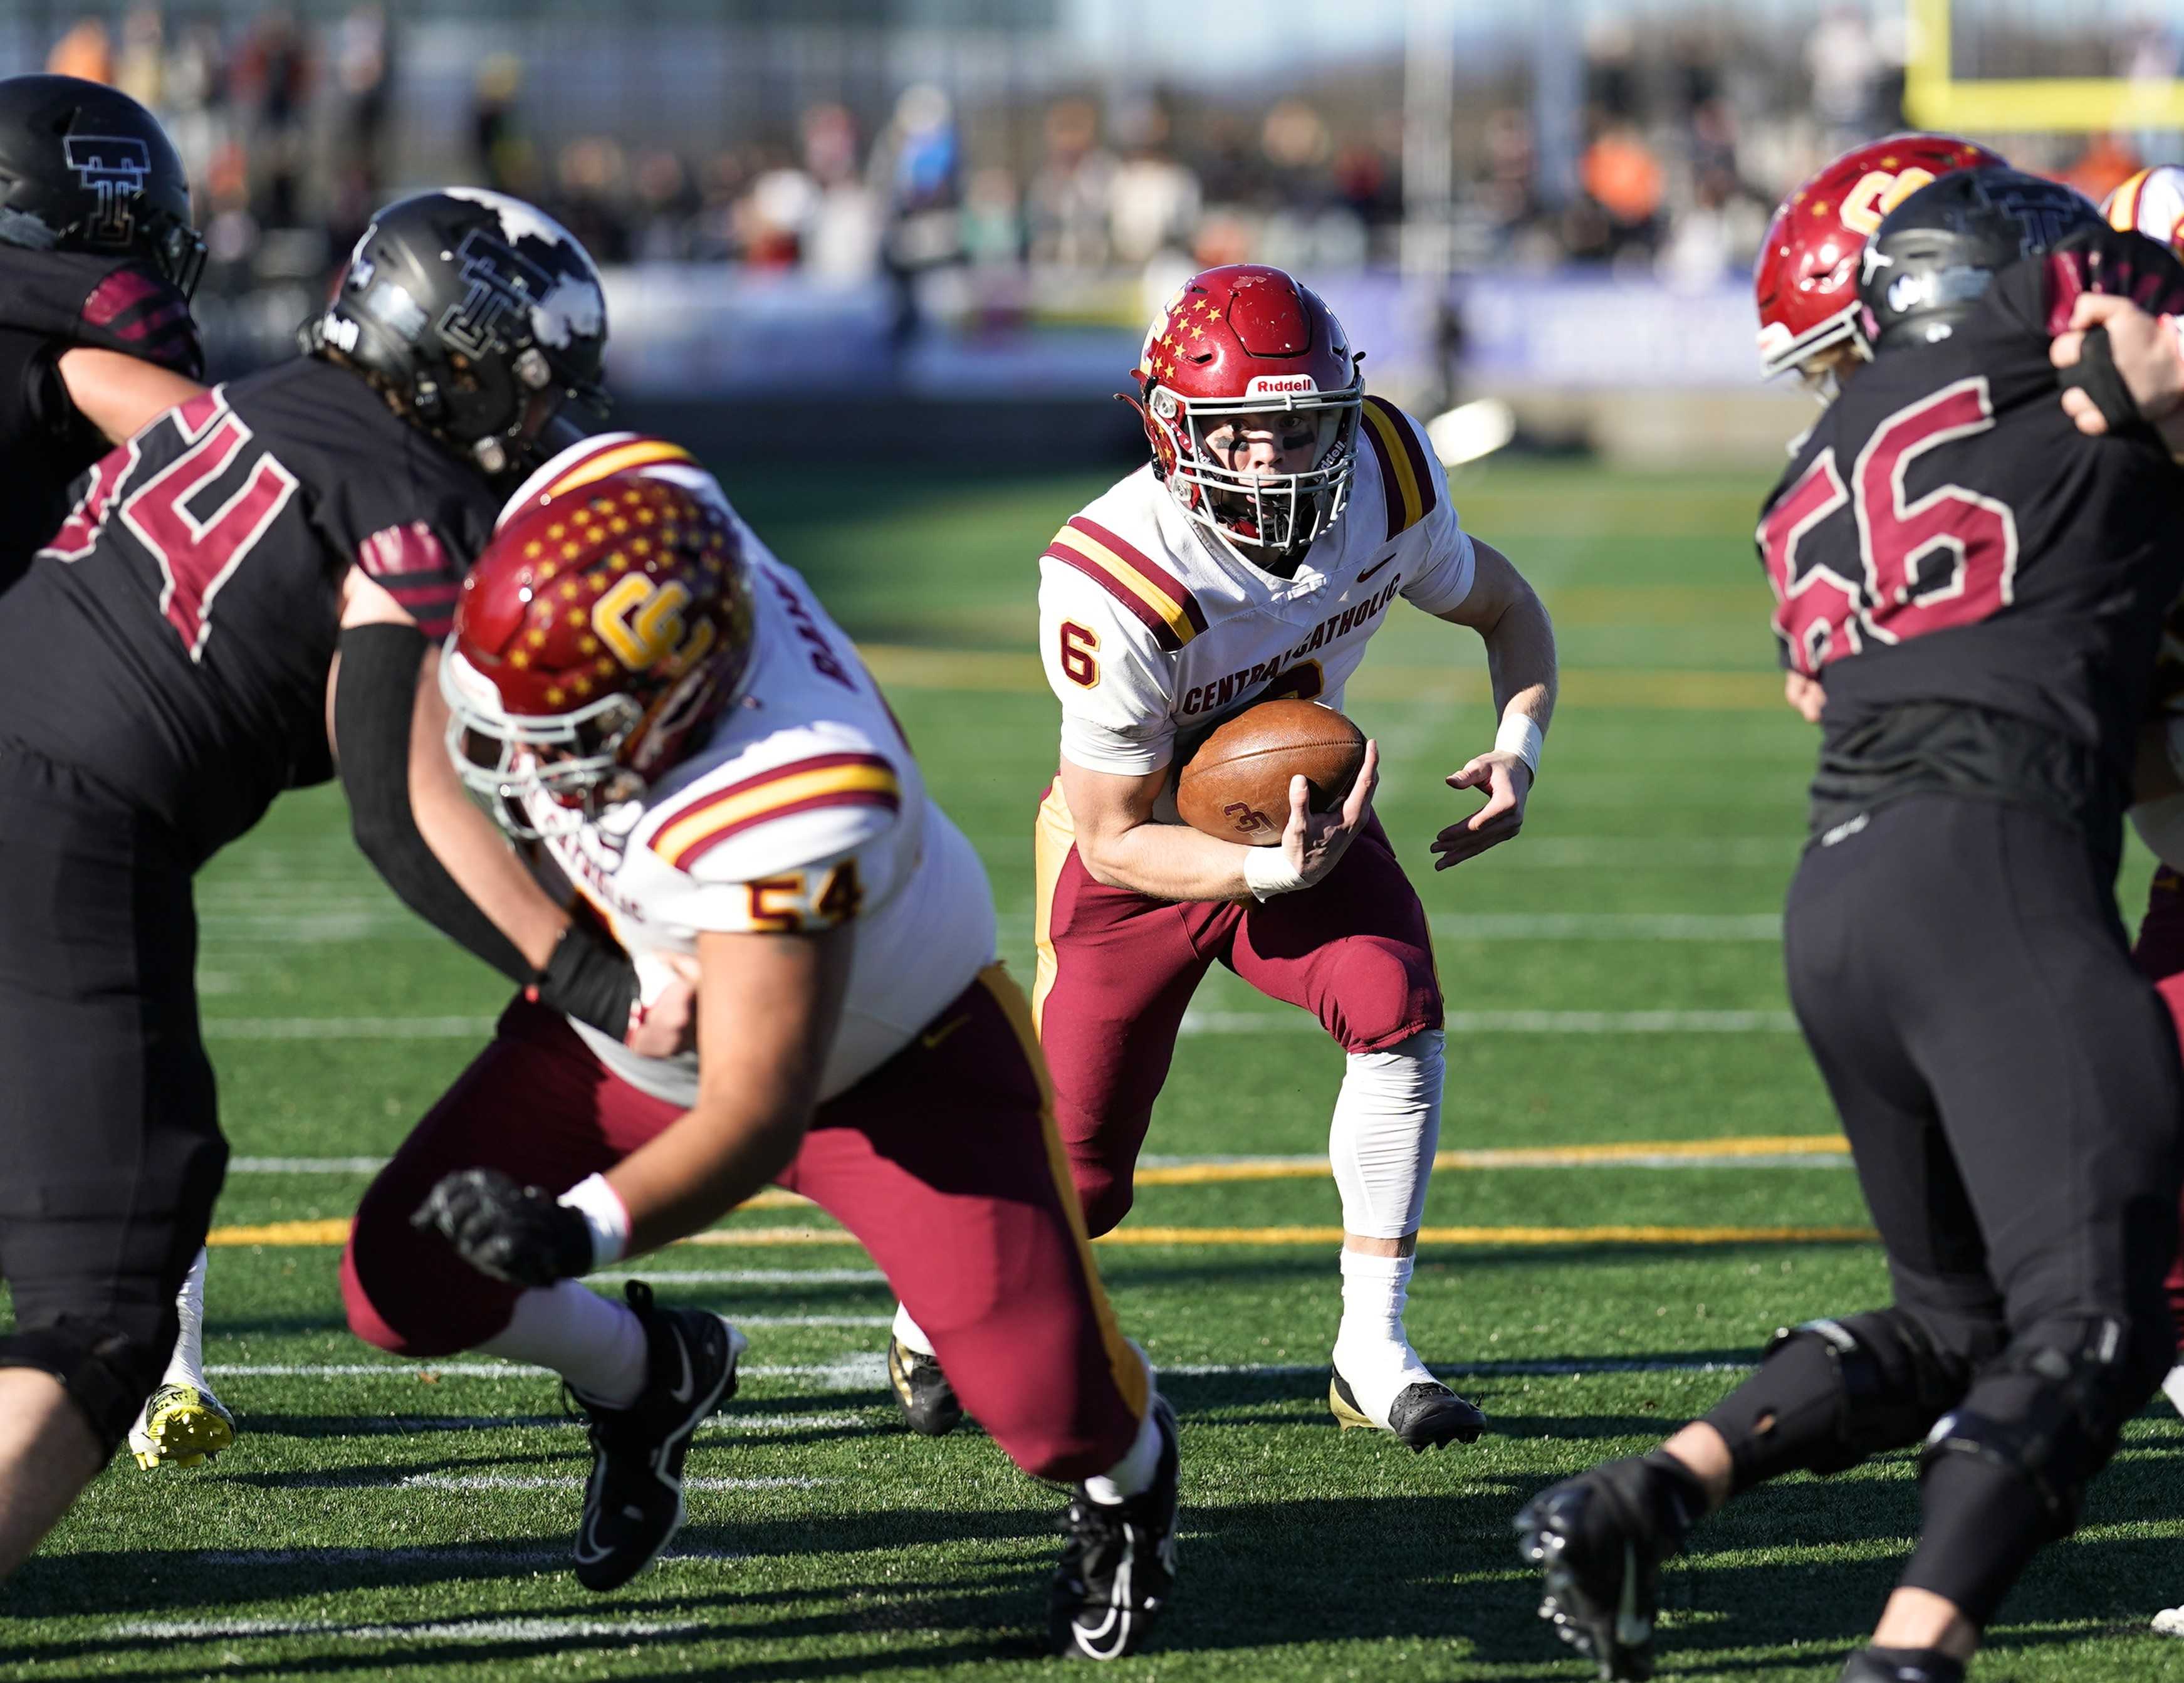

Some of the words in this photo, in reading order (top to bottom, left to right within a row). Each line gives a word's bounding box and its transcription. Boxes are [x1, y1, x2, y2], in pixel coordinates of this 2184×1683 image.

[1258, 379, 1311, 392] Riddell
[1313, 440, 1346, 483] ddell
[1756, 376, 2019, 677] 66
[1059, 617, 1100, 689] 6
[743, 857, 865, 933] 54
